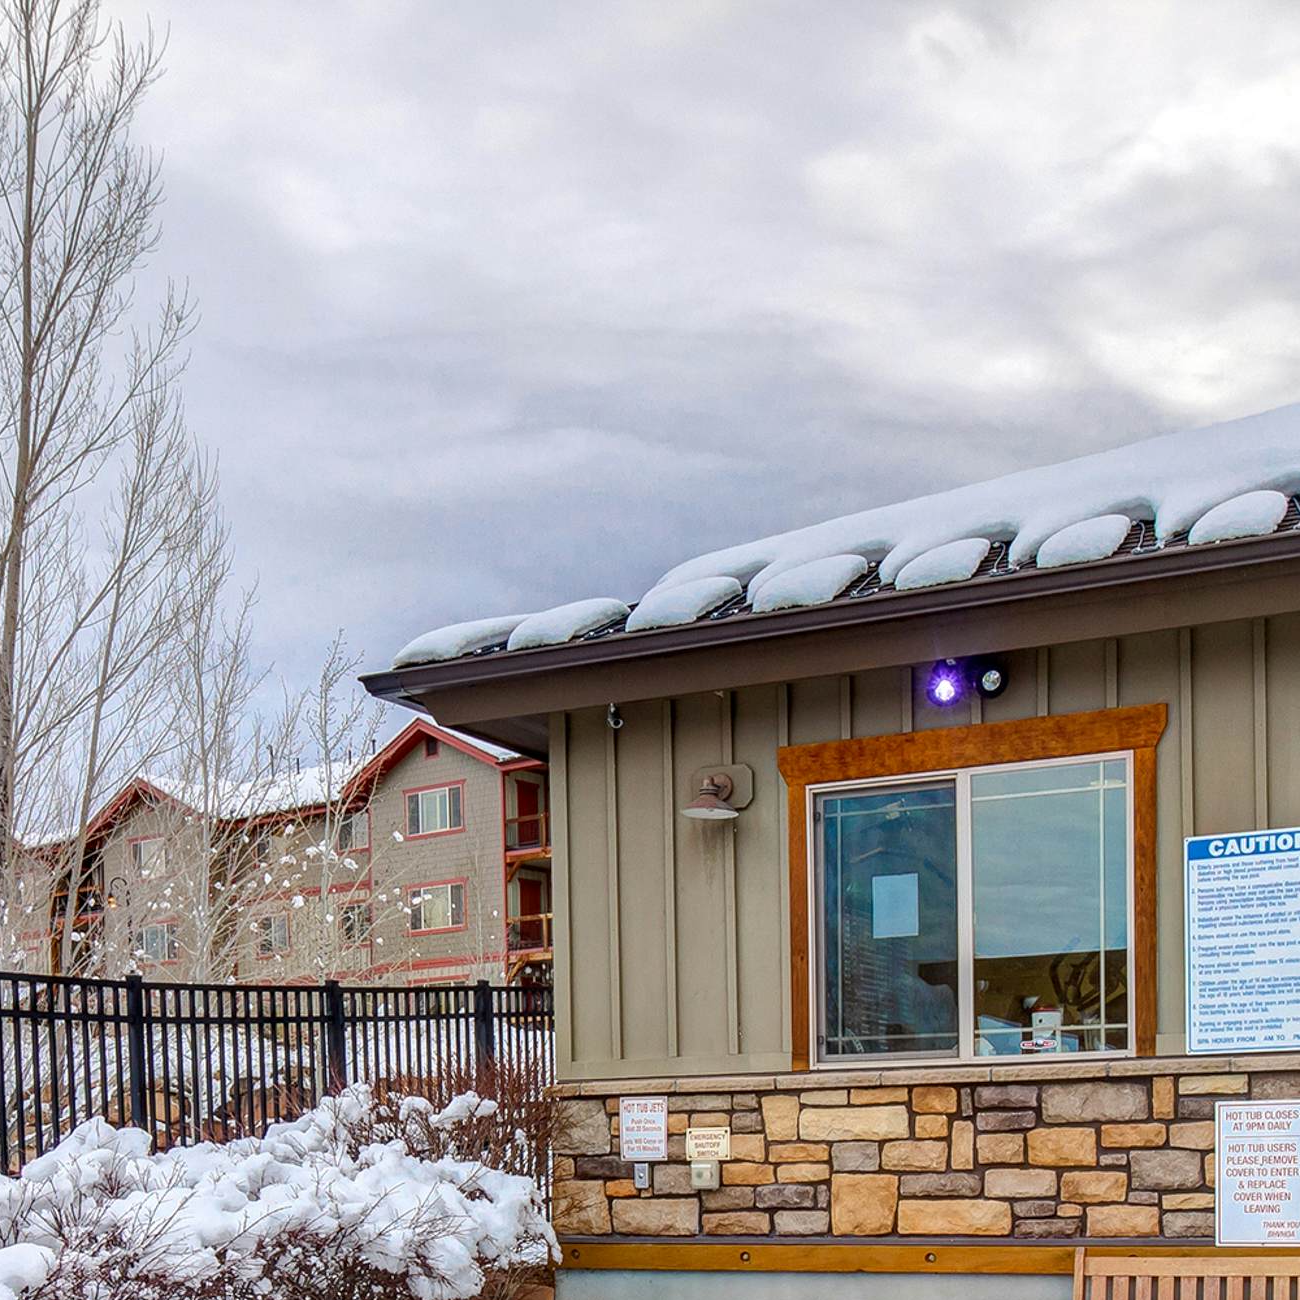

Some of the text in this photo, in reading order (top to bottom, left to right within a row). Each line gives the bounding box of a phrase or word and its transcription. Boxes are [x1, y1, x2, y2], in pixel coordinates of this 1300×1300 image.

[624, 1103, 664, 1113] HOT TUB JETS
[1226, 1110, 1299, 1120] HOT TUB CLOSES
[1233, 1121, 1292, 1131] AT 9PM DAILY
[1228, 1143, 1297, 1153] HOT TUB USERS
[1227, 1156, 1298, 1165] PLEASE REMOVE
[1226, 1167, 1299, 1176] COVER TO ENTER
[1238, 1180, 1287, 1189] & REPLACE
[1234, 1192, 1292, 1201] COVER WHEN
[1244, 1205, 1281, 1213] LEAVING
[1263, 1221, 1285, 1229] THANK
